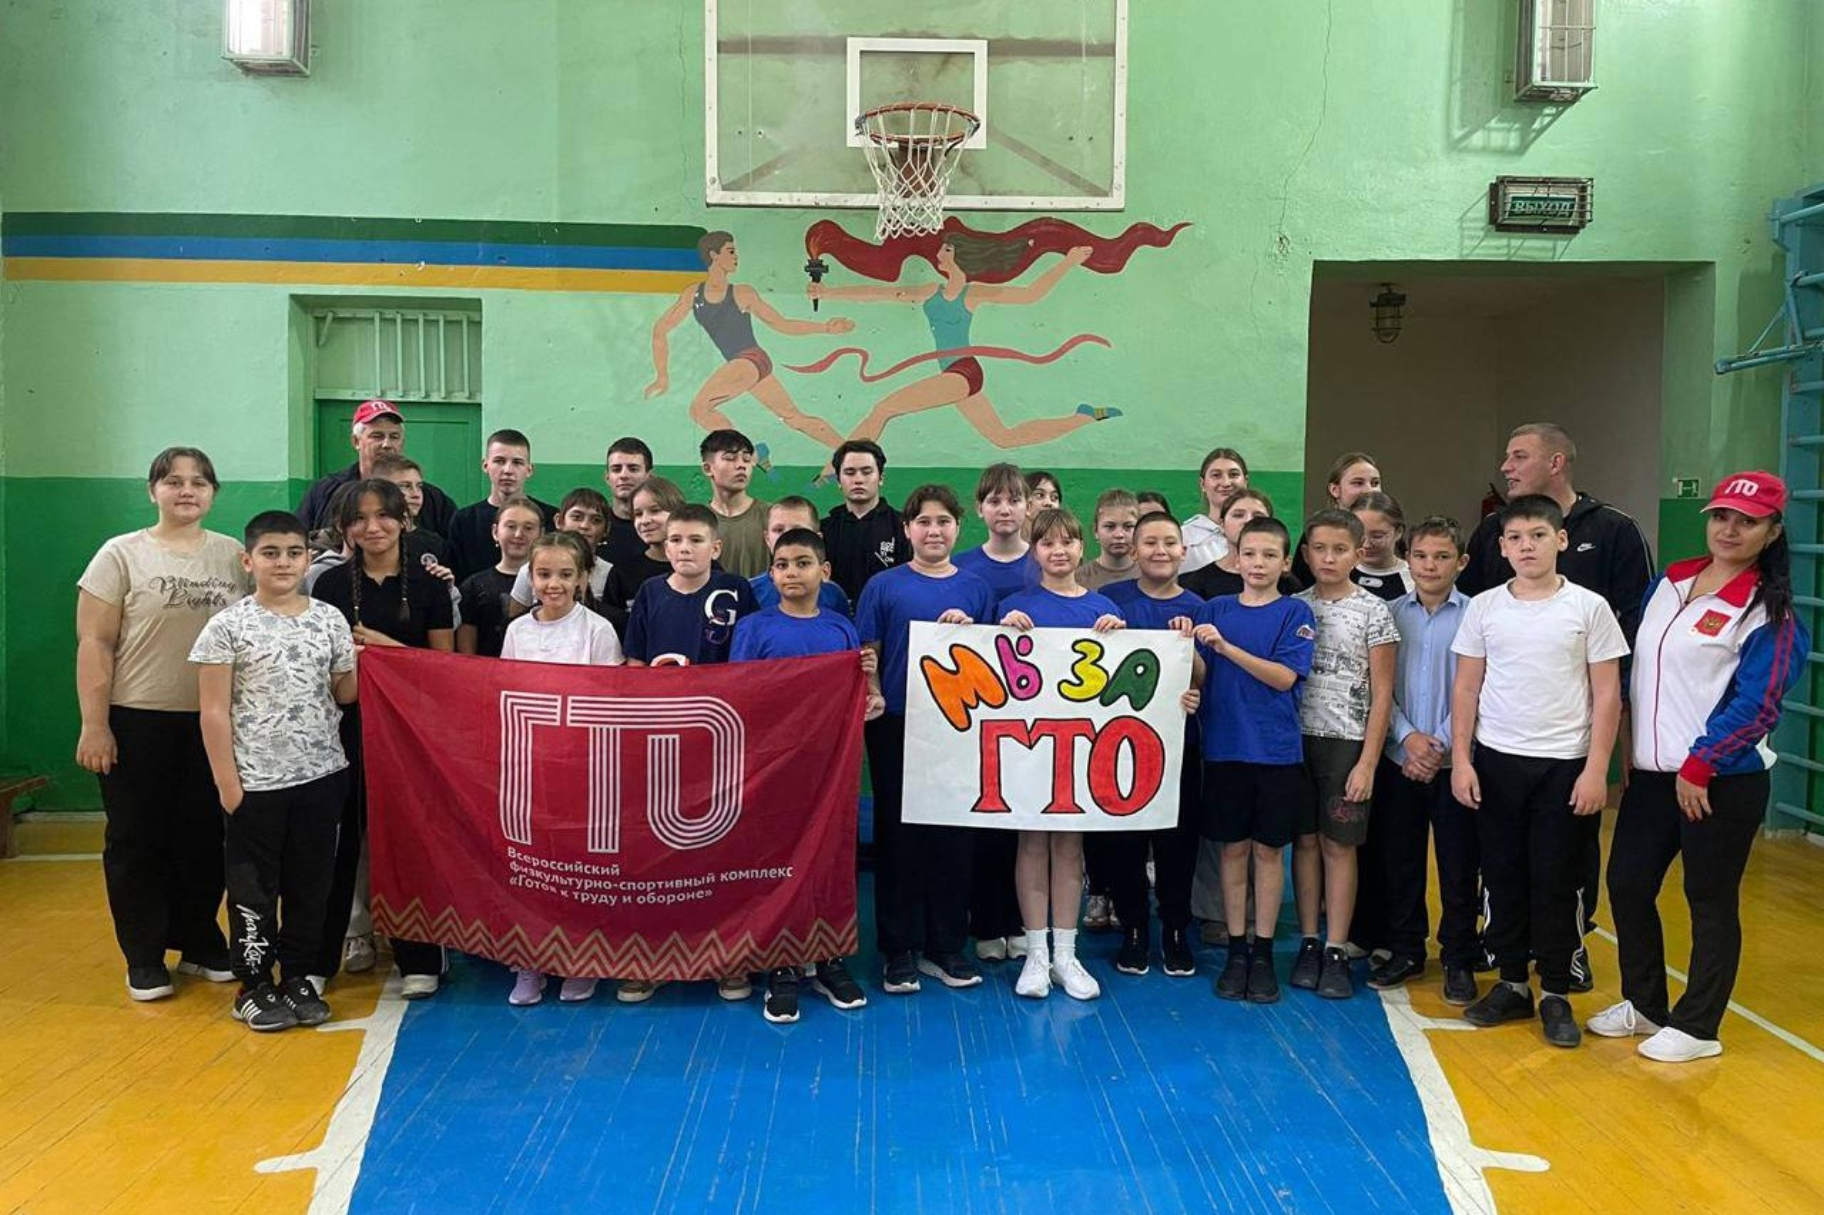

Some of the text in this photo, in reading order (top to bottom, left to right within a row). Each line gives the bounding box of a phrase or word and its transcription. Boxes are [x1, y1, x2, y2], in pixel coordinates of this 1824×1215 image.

[1513, 200, 1571, 218] ВЫХОД
[1724, 479, 1759, 497] ГТО
[919, 633, 1161, 733] МЫ ЗА
[500, 690, 745, 853] ГТО
[970, 715, 1165, 816] ГТО
[507, 846, 620, 876] Всероссийский
[510, 861, 794, 893] физкультурно-спортивный комплекс
[560, 889, 569, 898] к
[573, 891, 618, 907] труду
[622, 895, 632, 904] и
[637, 889, 713, 906] обороне»
